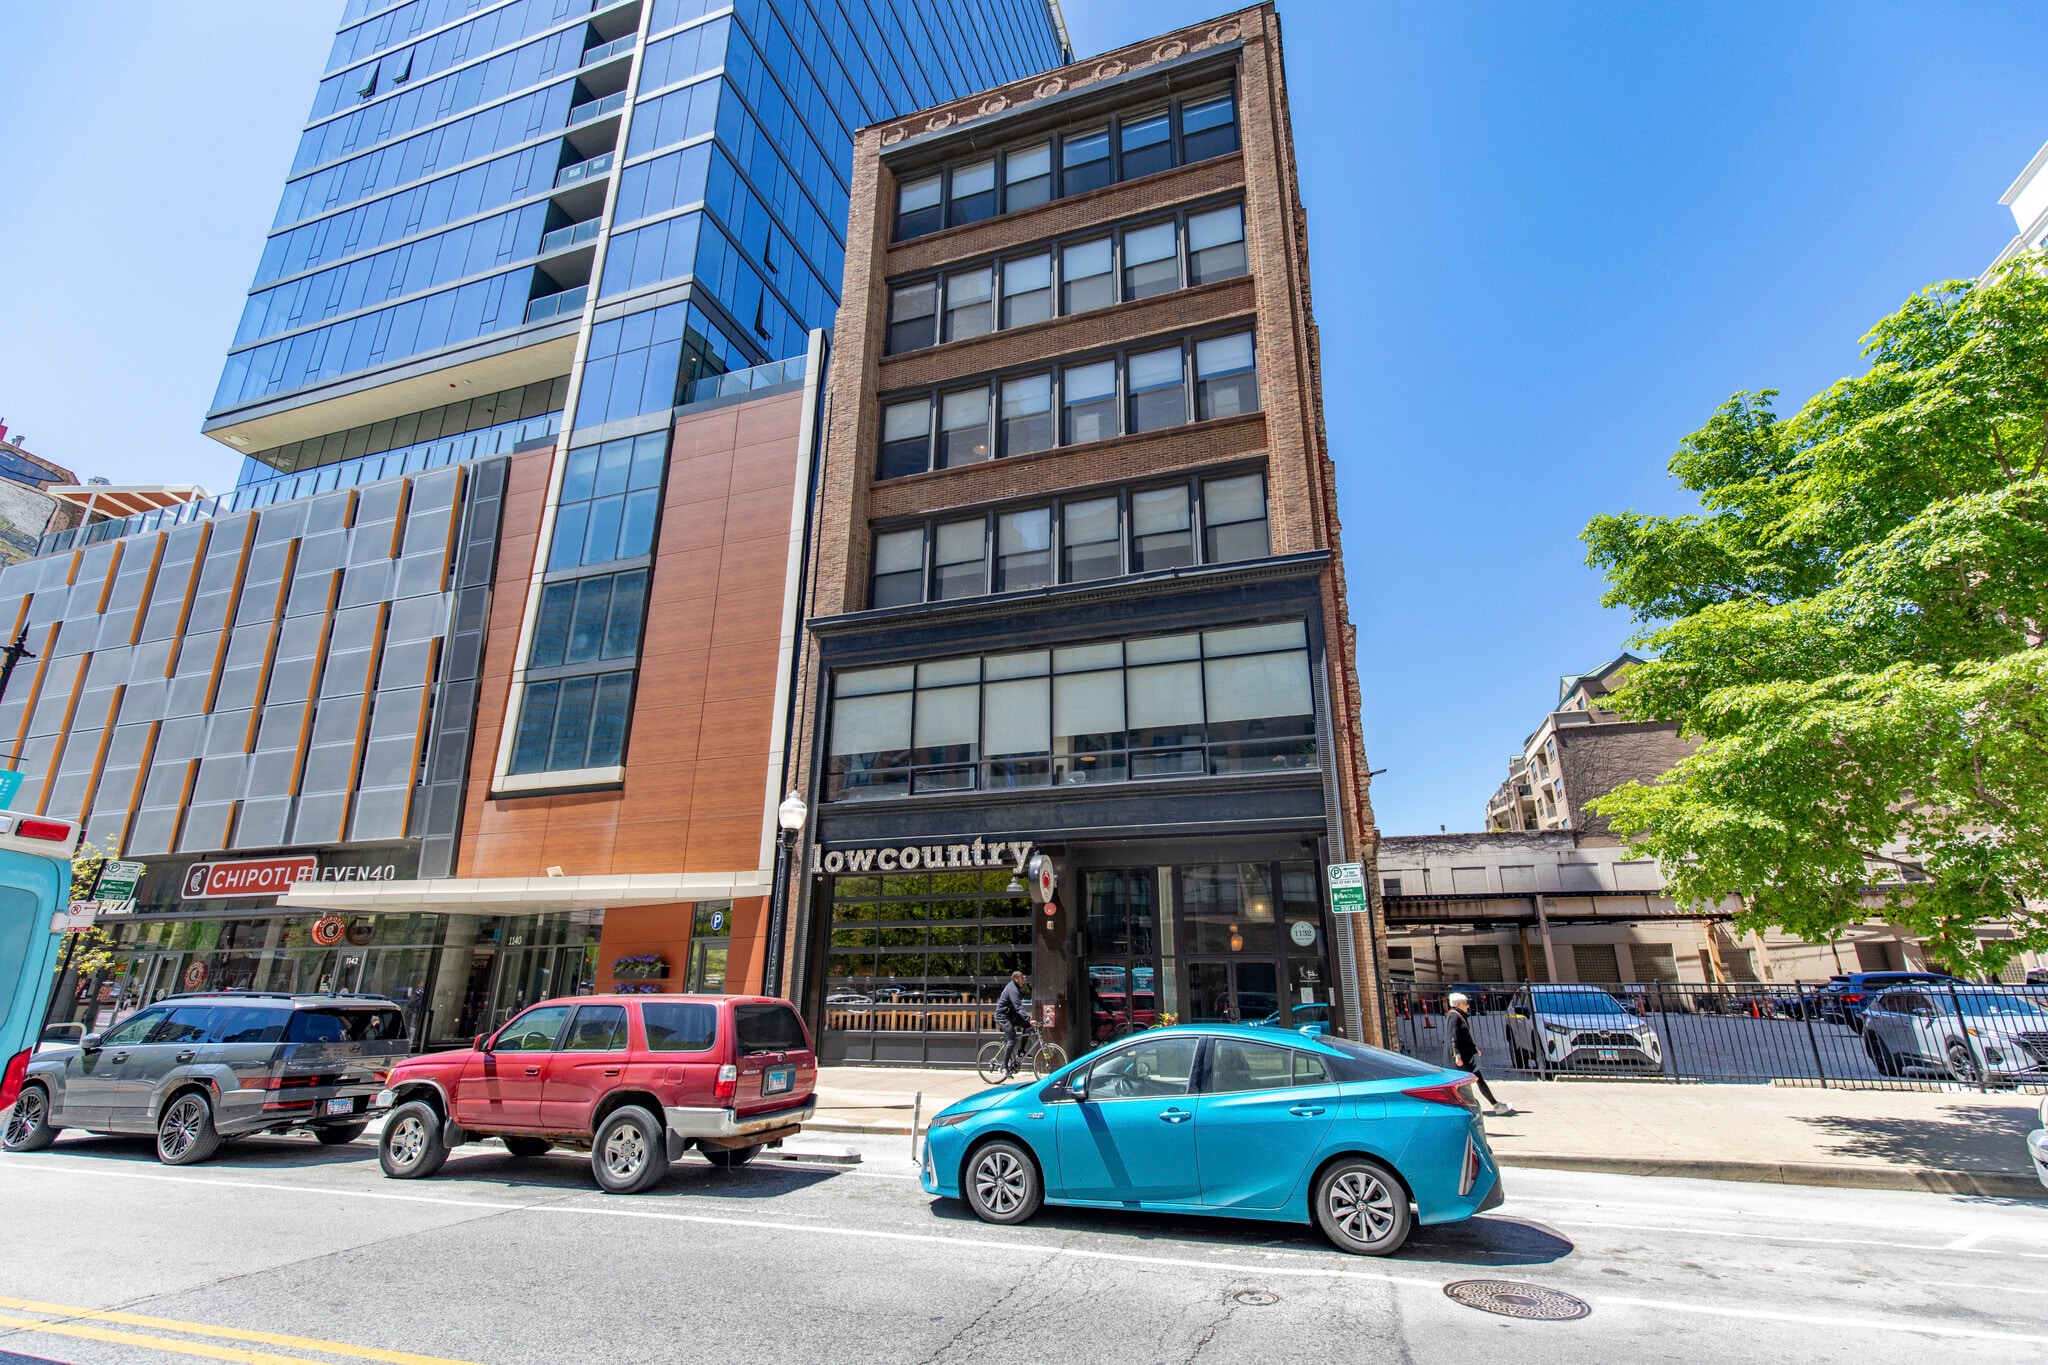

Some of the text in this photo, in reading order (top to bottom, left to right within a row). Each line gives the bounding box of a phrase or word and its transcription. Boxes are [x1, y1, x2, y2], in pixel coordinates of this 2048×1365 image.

[812, 837, 1033, 874] lowcountry
[212, 866, 309, 889] CHIPOTLE
[1294, 929, 1312, 937] 1132
[508, 935, 523, 946] 1140
[345, 957, 359, 965] 1142
